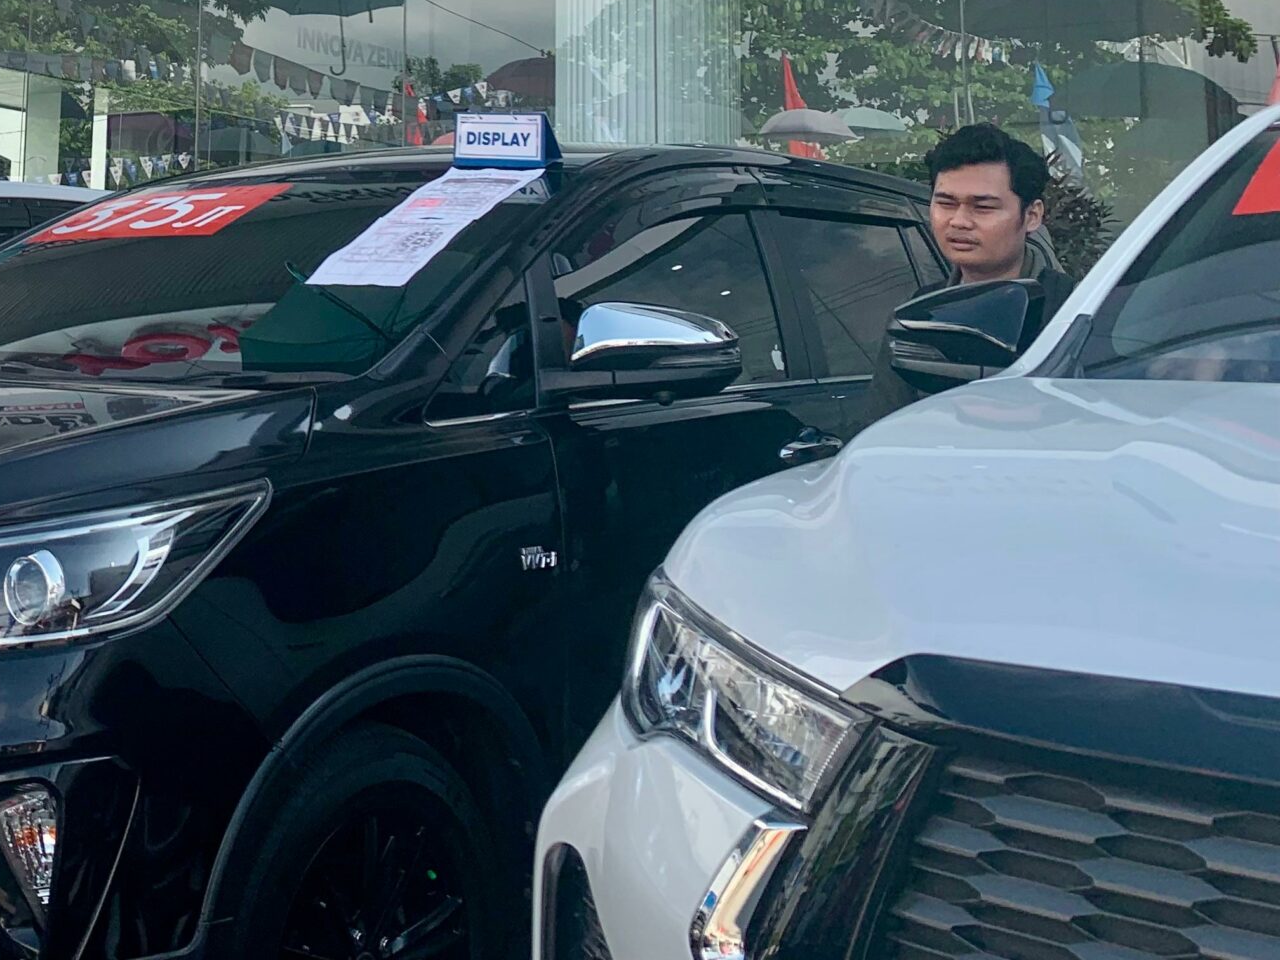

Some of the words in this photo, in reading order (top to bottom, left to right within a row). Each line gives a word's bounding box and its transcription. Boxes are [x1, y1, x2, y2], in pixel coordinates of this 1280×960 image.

[297, 27, 366, 65] INNOVA
[367, 44, 403, 71] ZENI
[466, 131, 531, 147] DISPLAY
